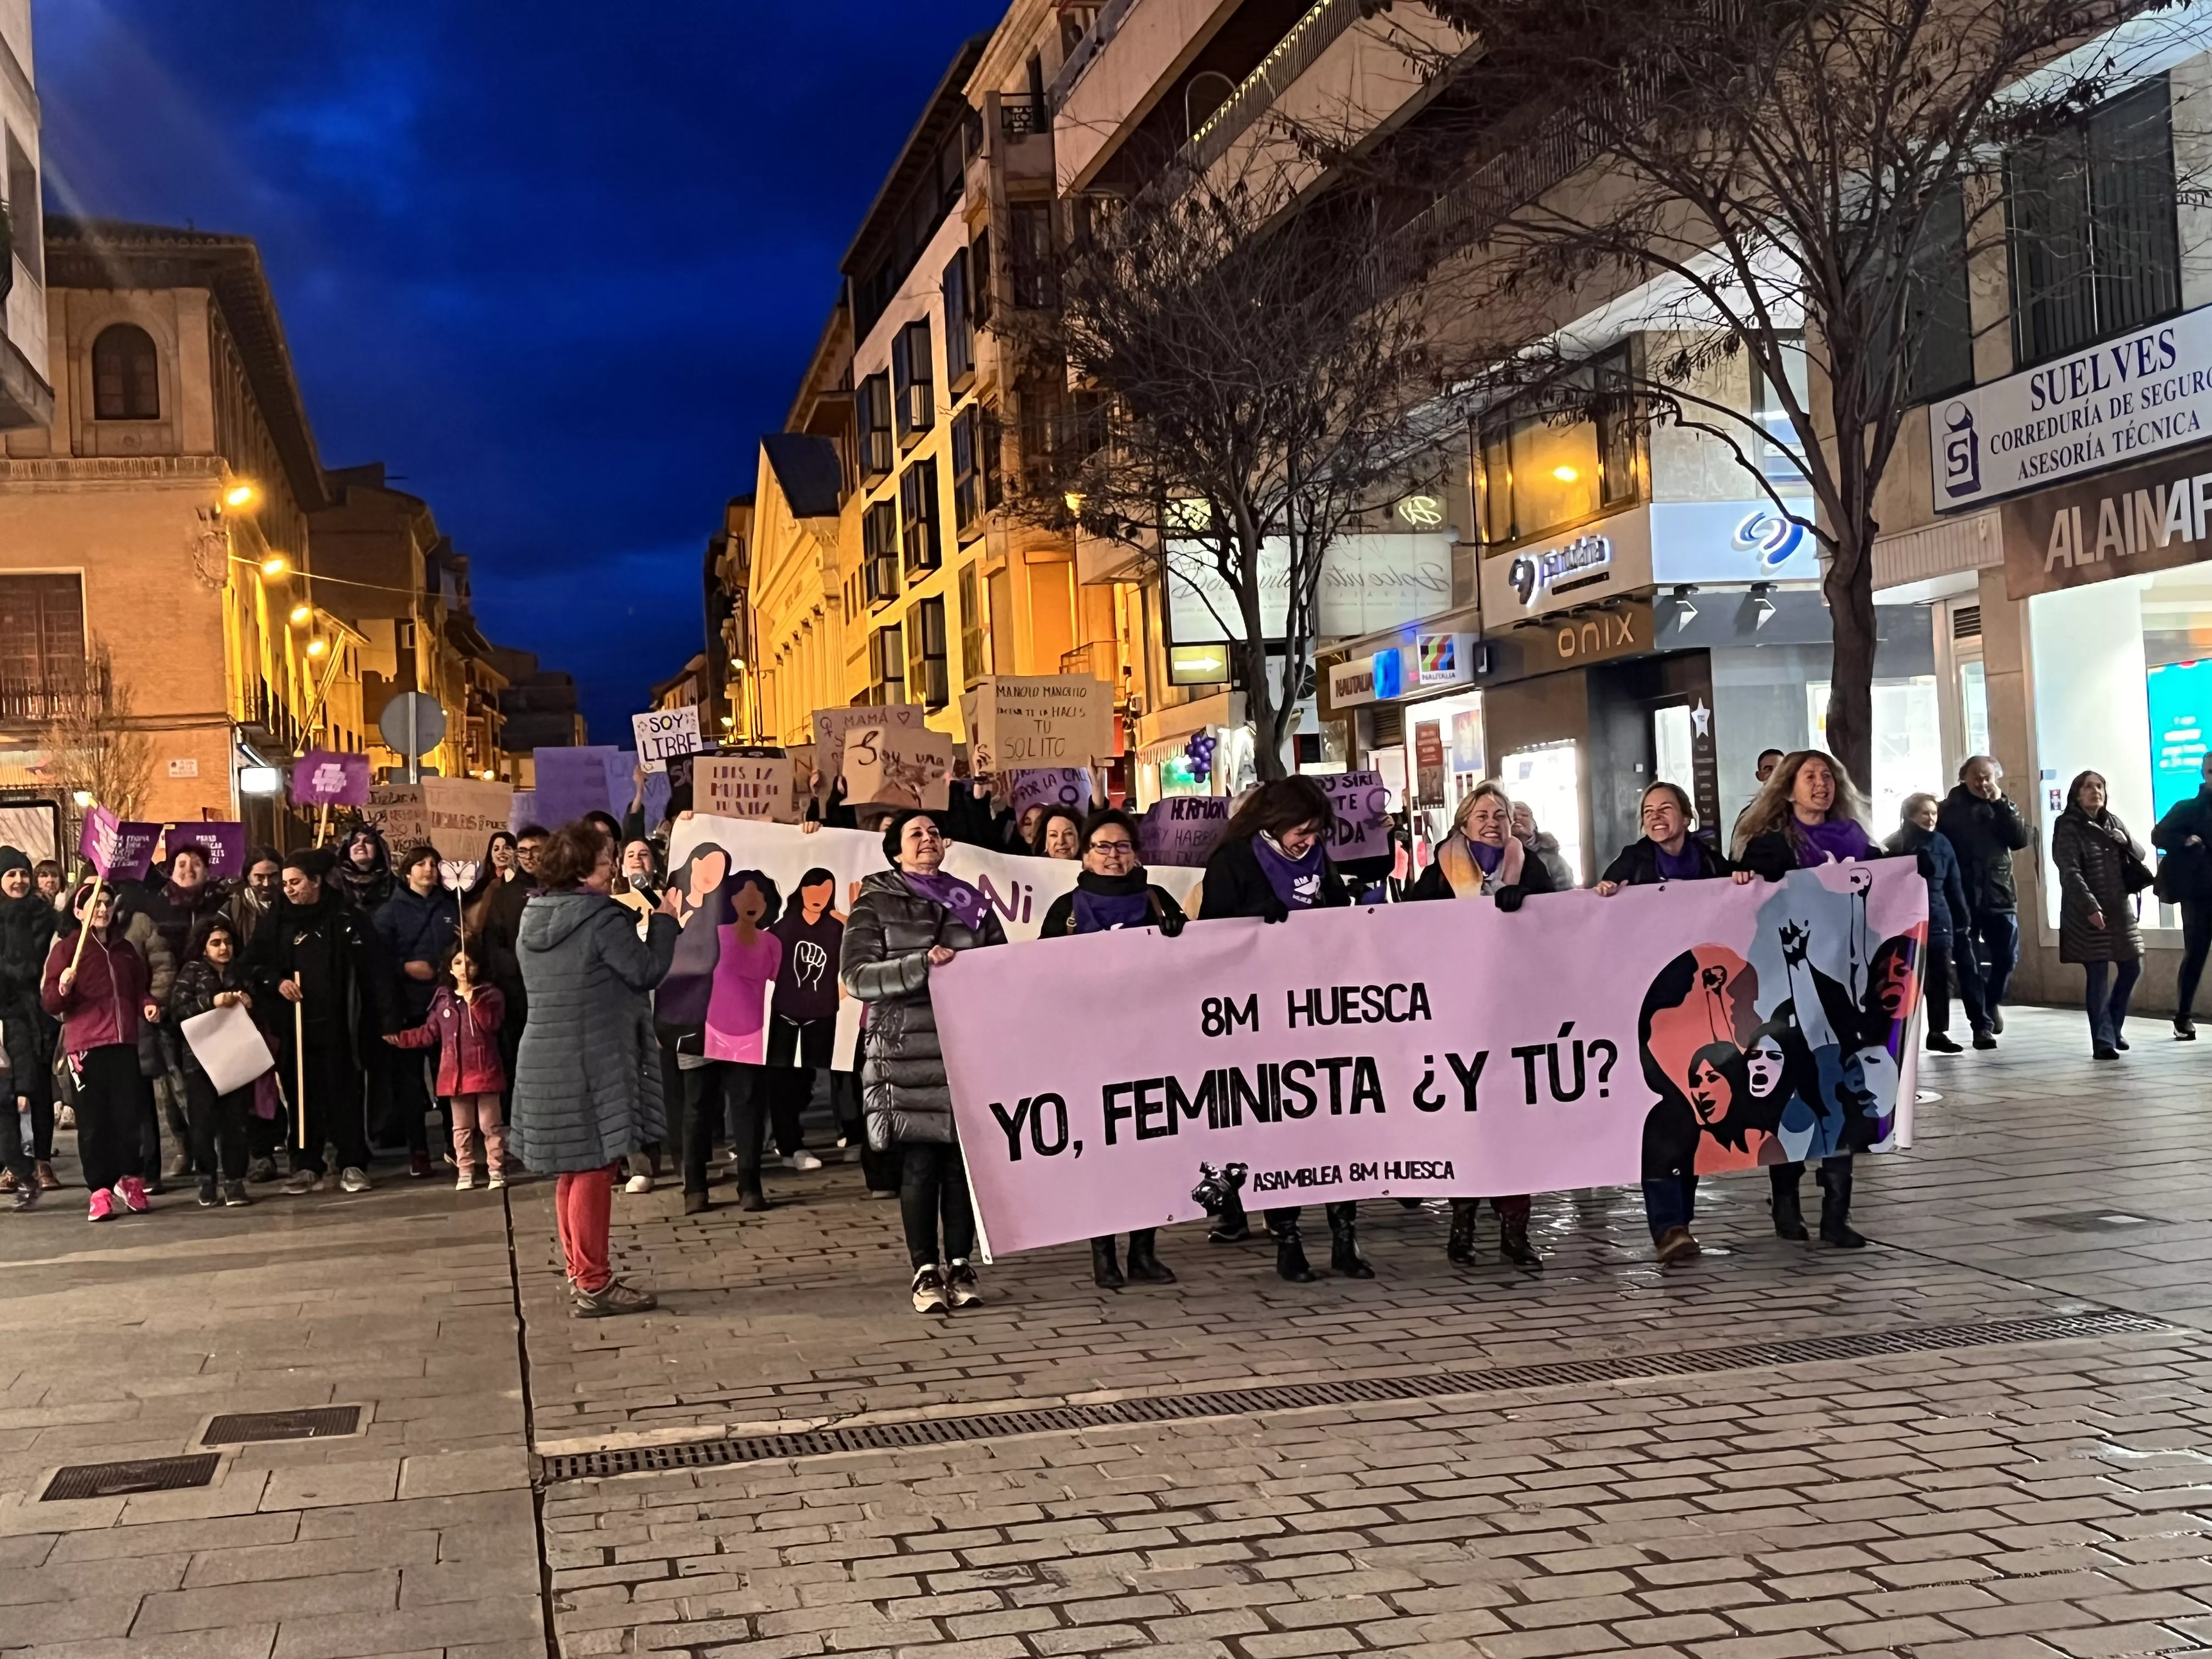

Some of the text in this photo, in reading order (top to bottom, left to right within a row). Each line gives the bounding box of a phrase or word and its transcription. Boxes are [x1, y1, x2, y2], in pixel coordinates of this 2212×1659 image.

[2031, 328, 2176, 412] SUELVES
[1990, 398, 2102, 454] CORREDURÍA
[2109, 393, 2134, 419] DE
[2018, 410, 2200, 481] ASESORÍA TÉCNICA
[649, 714, 683, 733] SOY
[844, 708, 888, 727] MAMÁ
[1003, 737, 1065, 759] SOLITO
[1201, 983, 1432, 1037] 8M HUESCA
[989, 1021, 1618, 1162] YO, FEMINISTA ¿Y TÚ?
[1253, 1160, 1455, 1192] ASAMBLEA 8M HUESCA
